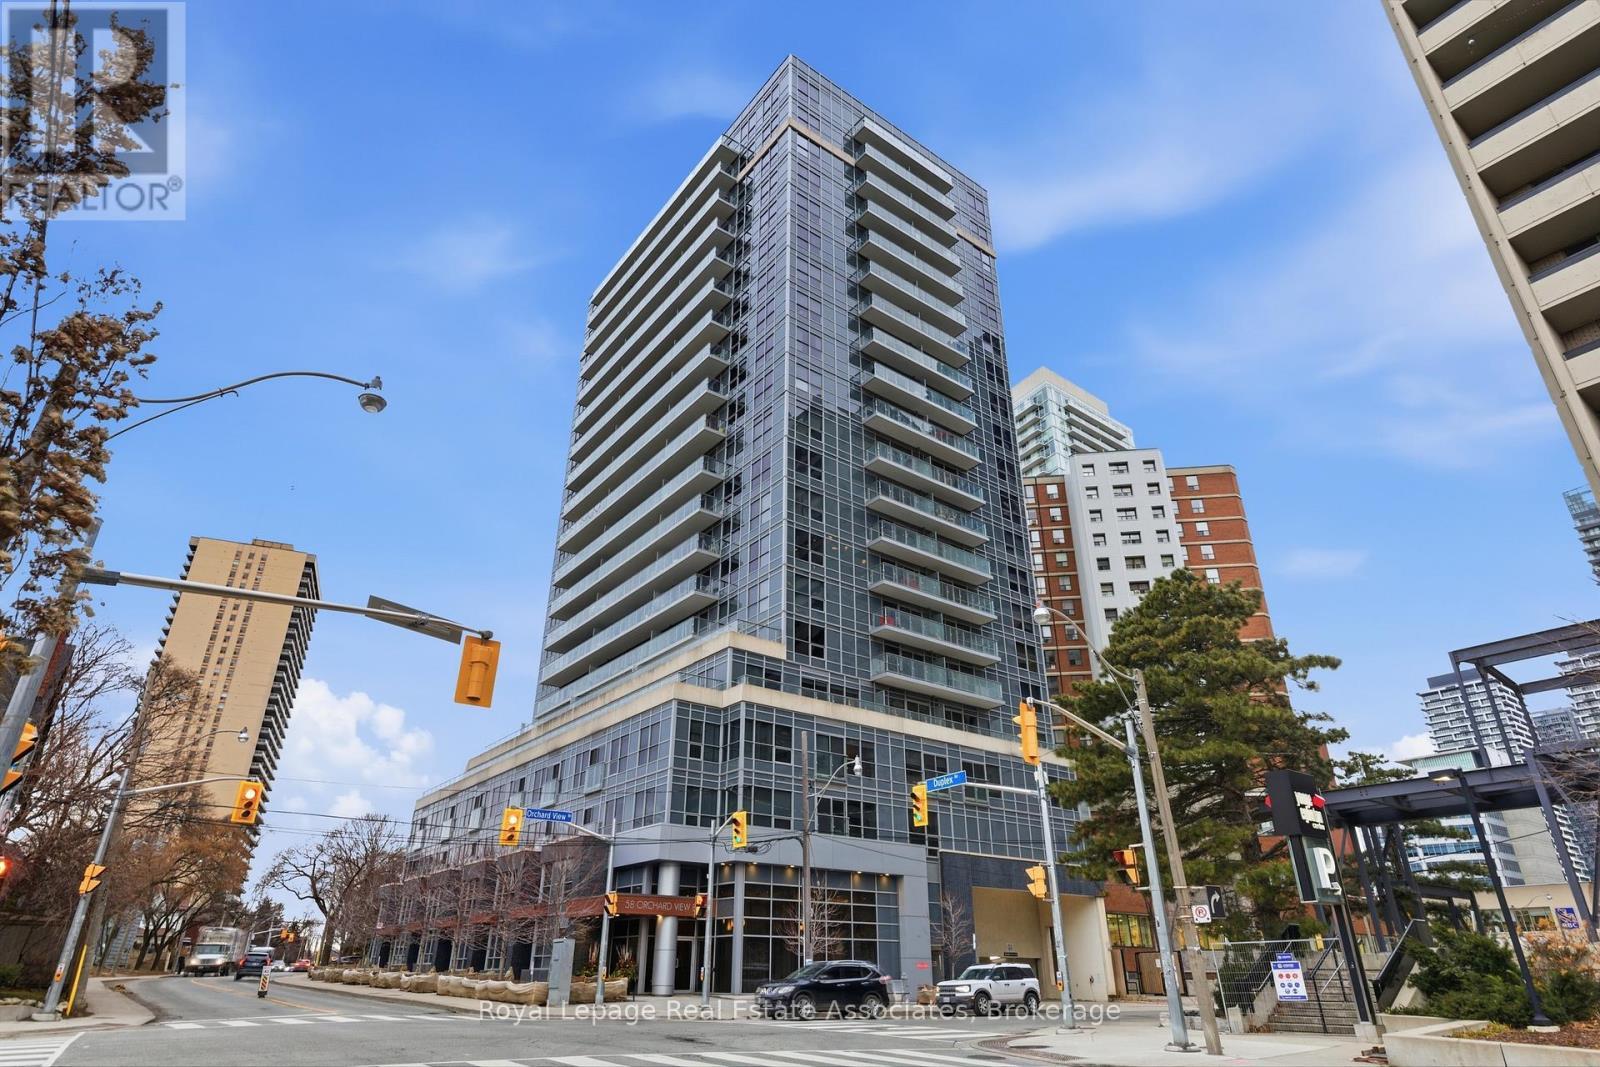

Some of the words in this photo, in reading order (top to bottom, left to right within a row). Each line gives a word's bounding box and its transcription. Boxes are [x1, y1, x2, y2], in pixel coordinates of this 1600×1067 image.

[934, 776, 953, 788] Duplex
[527, 810, 551, 819] Orchard
[552, 812, 567, 820] View
[636, 900, 673, 911] ORCHARD
[673, 903, 691, 912] VIEW
